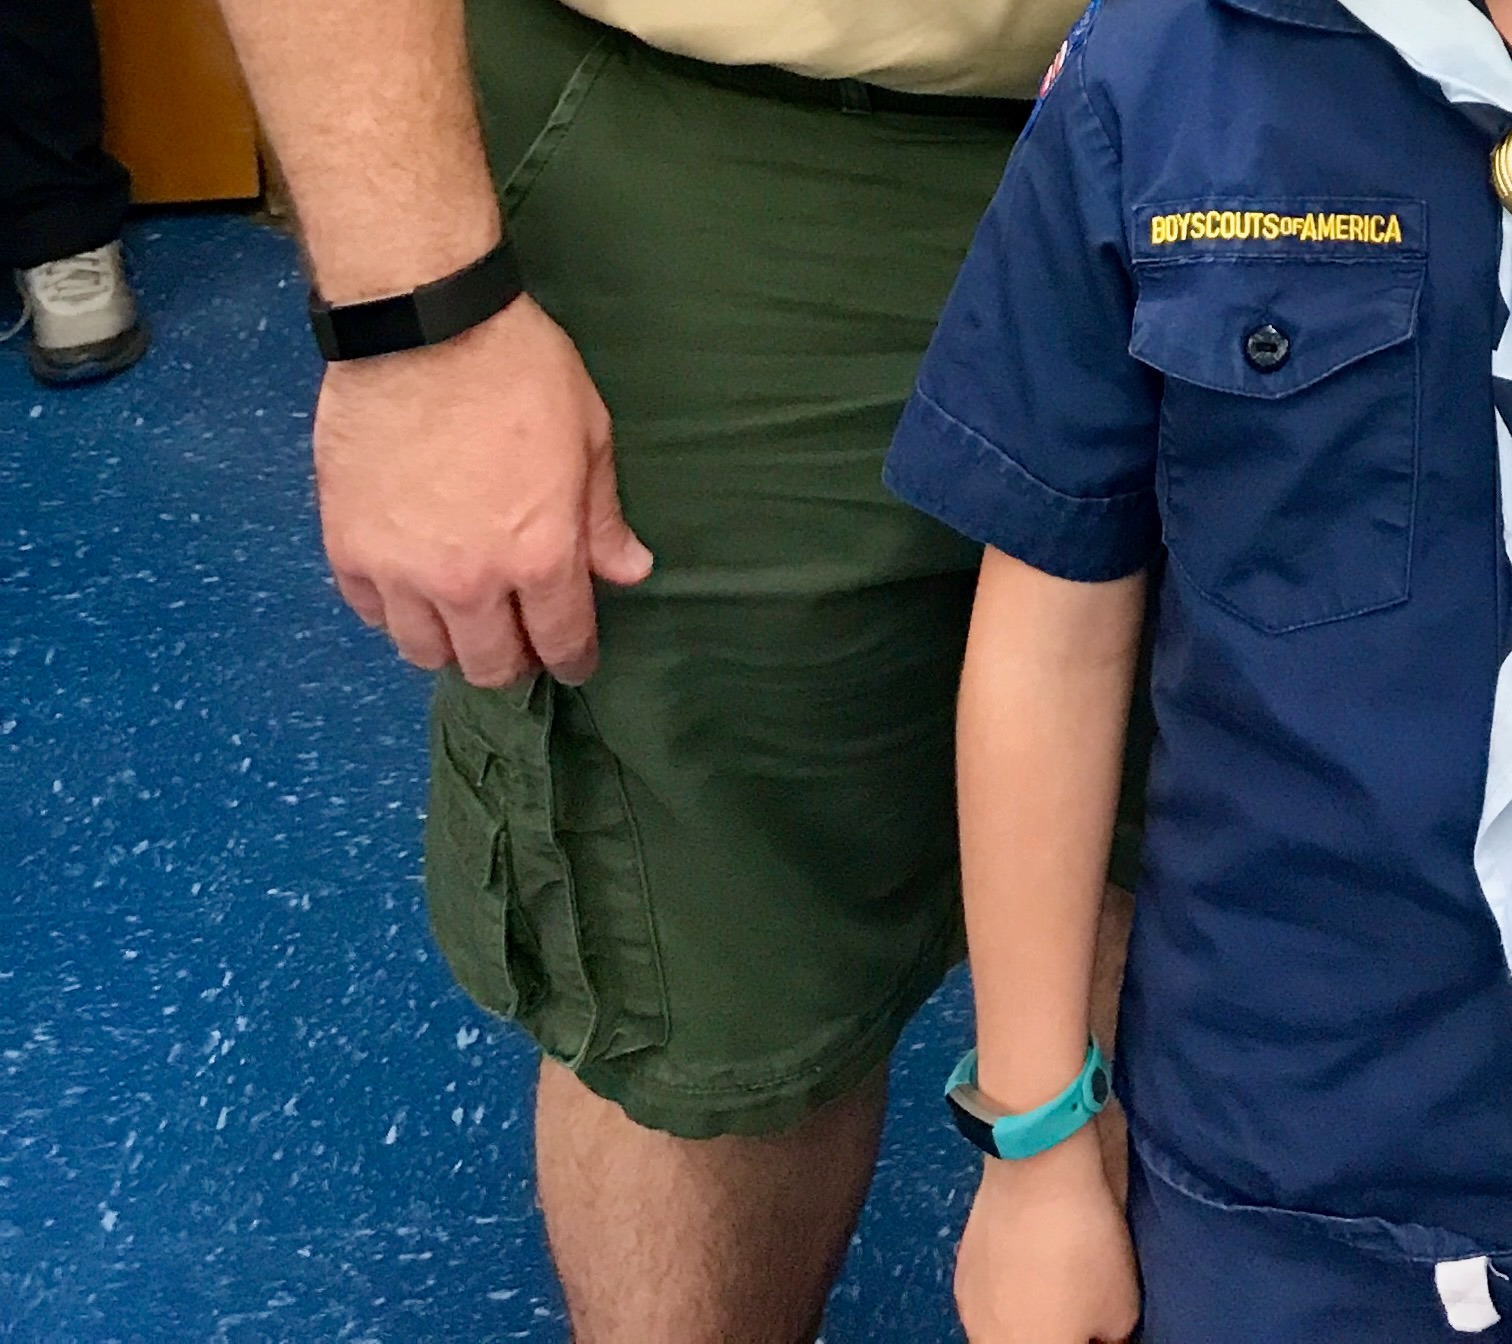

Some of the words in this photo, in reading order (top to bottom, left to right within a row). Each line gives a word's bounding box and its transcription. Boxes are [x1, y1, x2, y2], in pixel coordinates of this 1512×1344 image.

[1151, 212, 1192, 245] BOY
[1190, 210, 1281, 241] SCOUTS
[1279, 216, 1304, 237] OF
[1300, 212, 1403, 244] AMERICA
